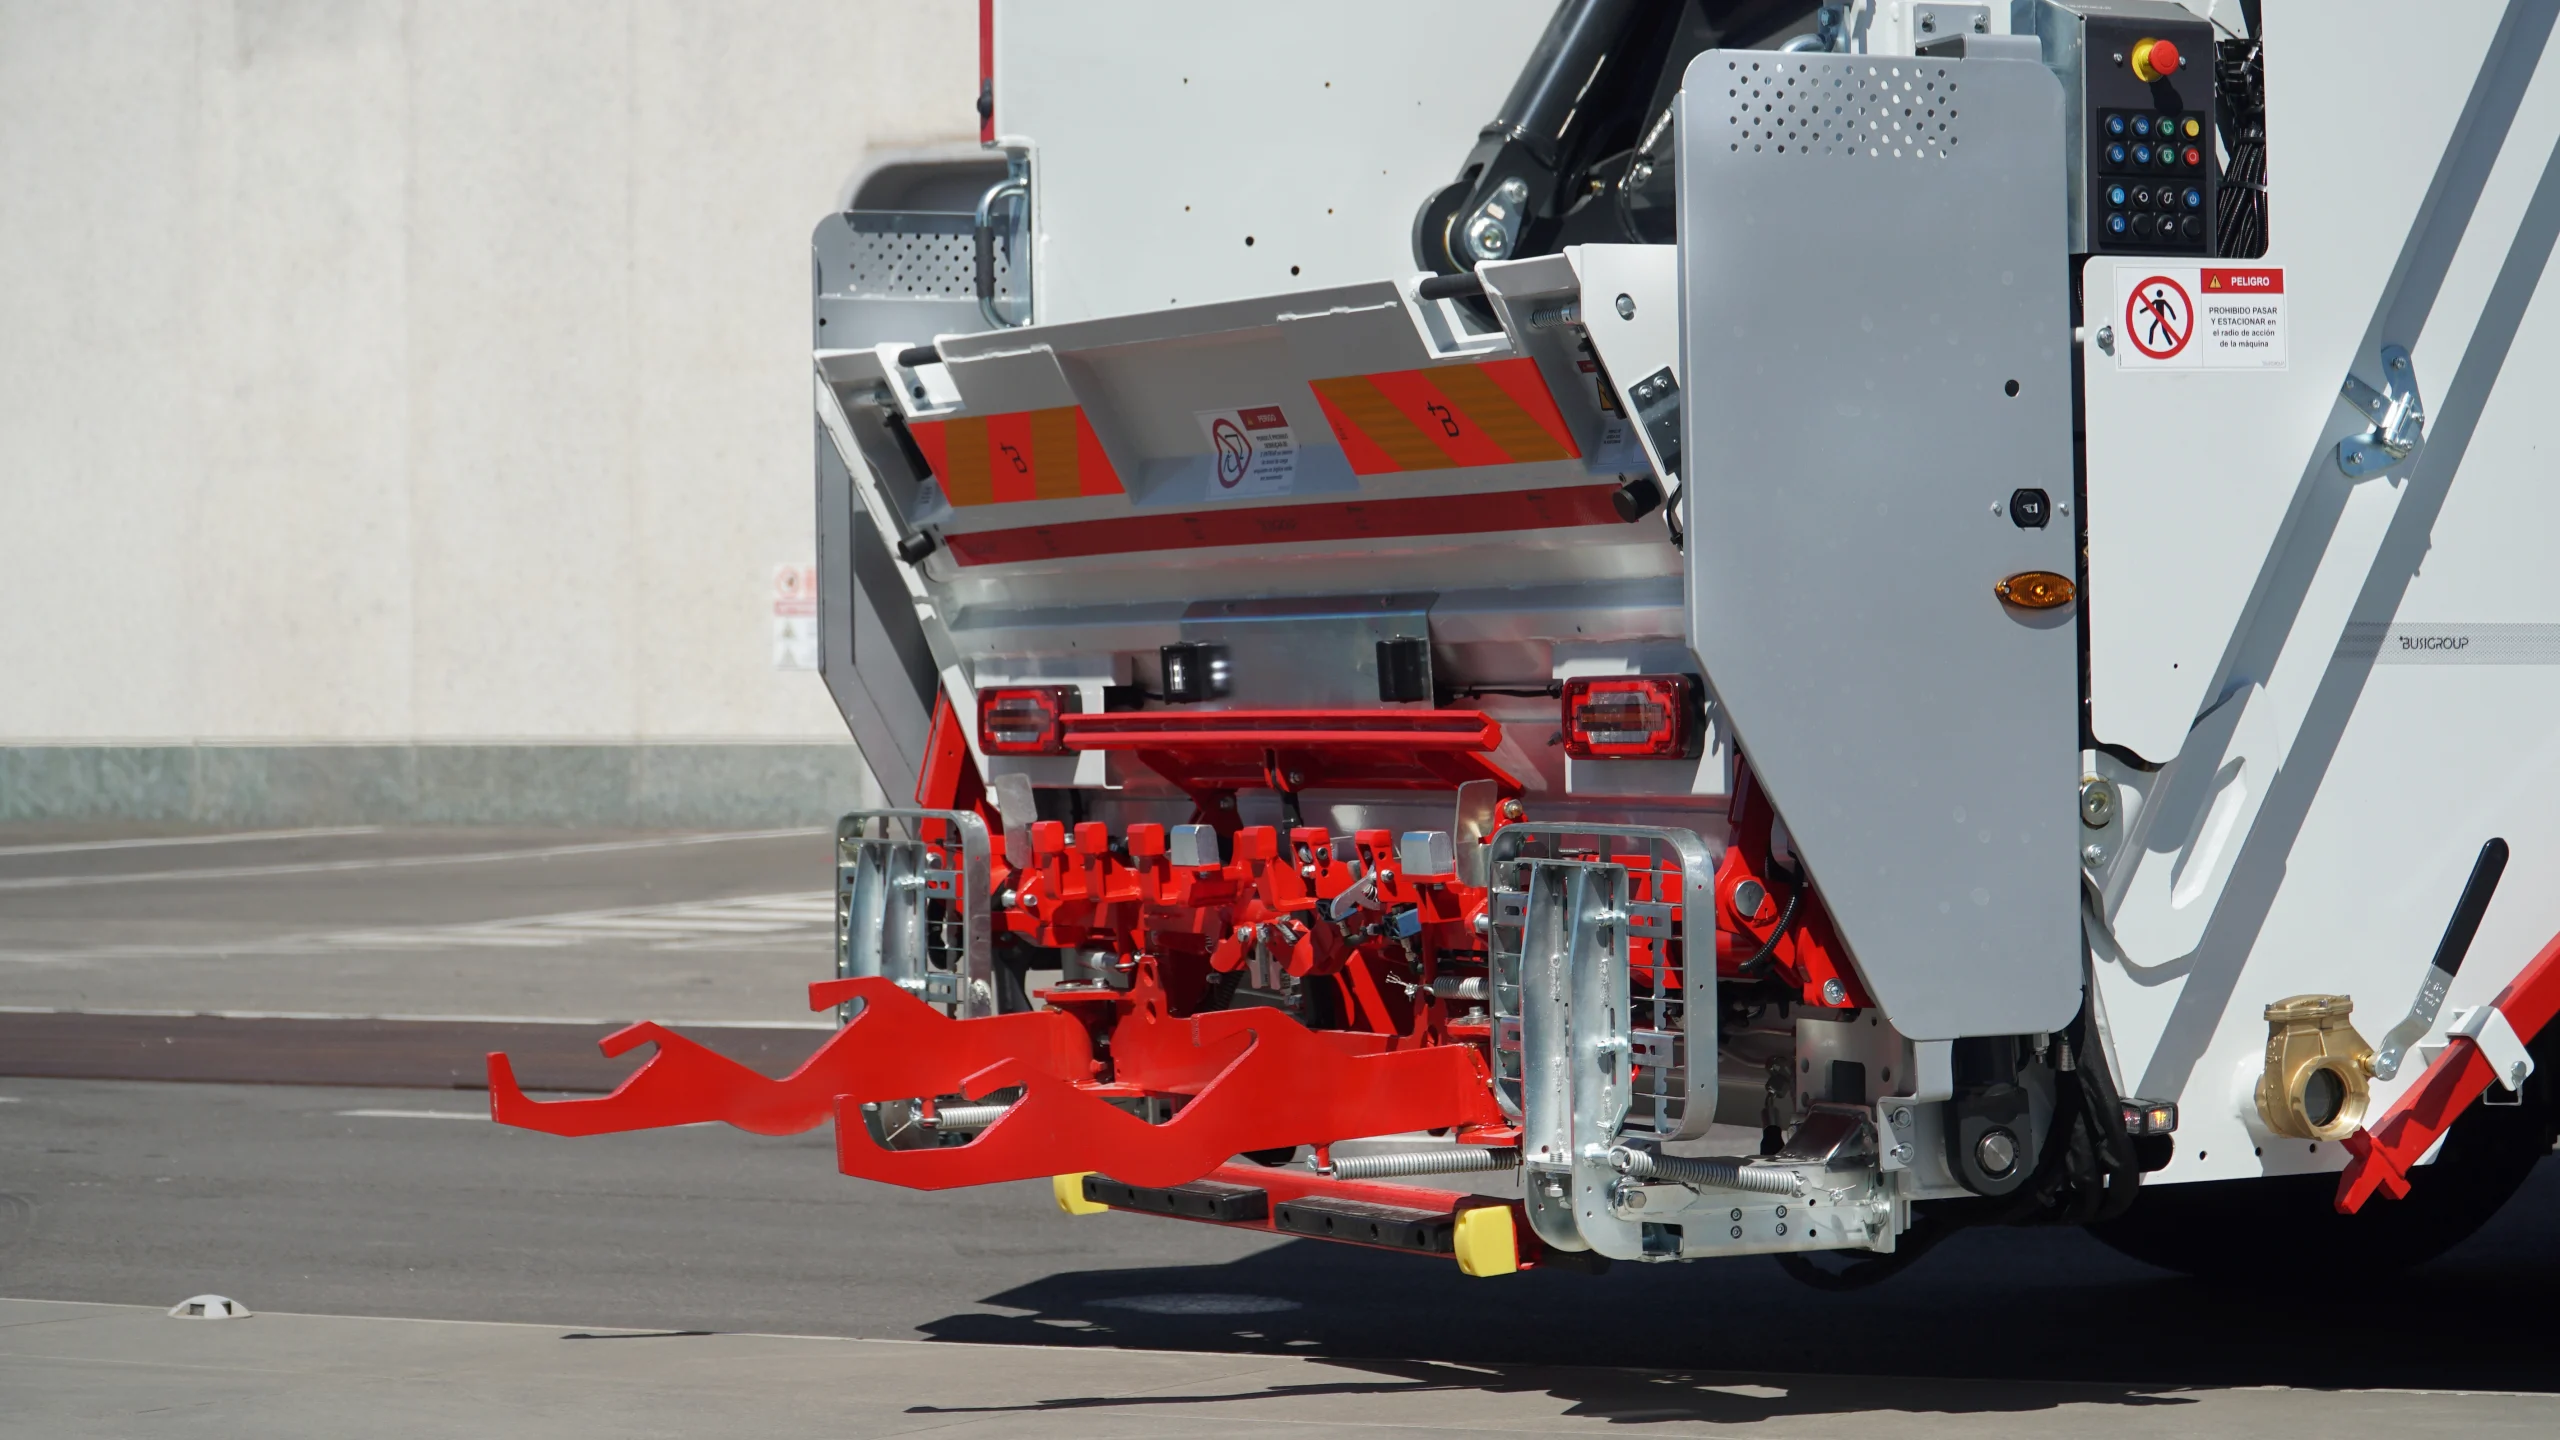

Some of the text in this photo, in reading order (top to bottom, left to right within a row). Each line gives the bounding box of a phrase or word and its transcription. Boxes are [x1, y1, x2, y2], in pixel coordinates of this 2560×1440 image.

[2230, 276, 2270, 287] PELIGRO
[2208, 306, 2278, 315] PROHIBIDO PASAR
[2210, 318, 2216, 326] Y
[2217, 318, 2266, 326] ESTACIONAR
[2212, 329, 2275, 337] el radio de acción
[2219, 340, 2269, 350] de la máquina
[2399, 636, 2469, 650] BUSIGROUP
